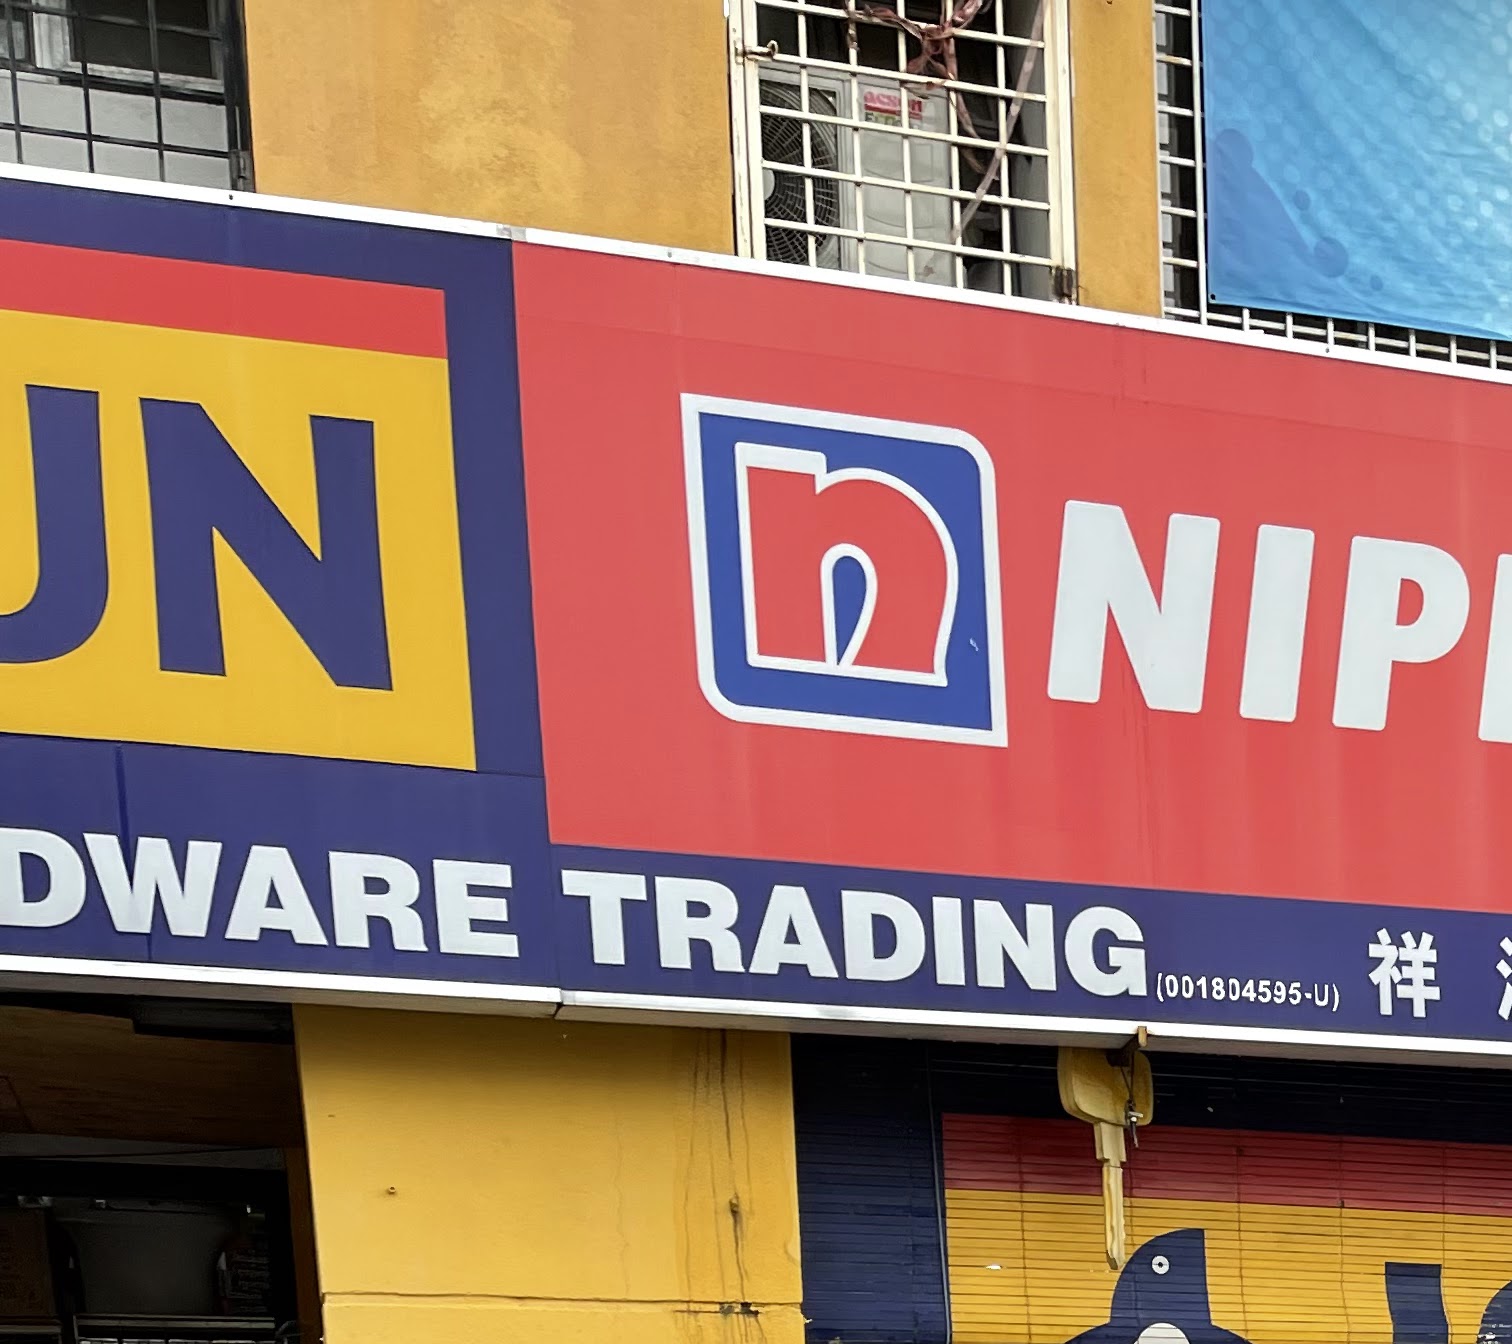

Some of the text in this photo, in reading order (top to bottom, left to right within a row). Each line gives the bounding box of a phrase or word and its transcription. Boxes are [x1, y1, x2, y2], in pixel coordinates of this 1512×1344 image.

[0, 828, 1340, 1012] DWARE TRADING (001804595-U)
